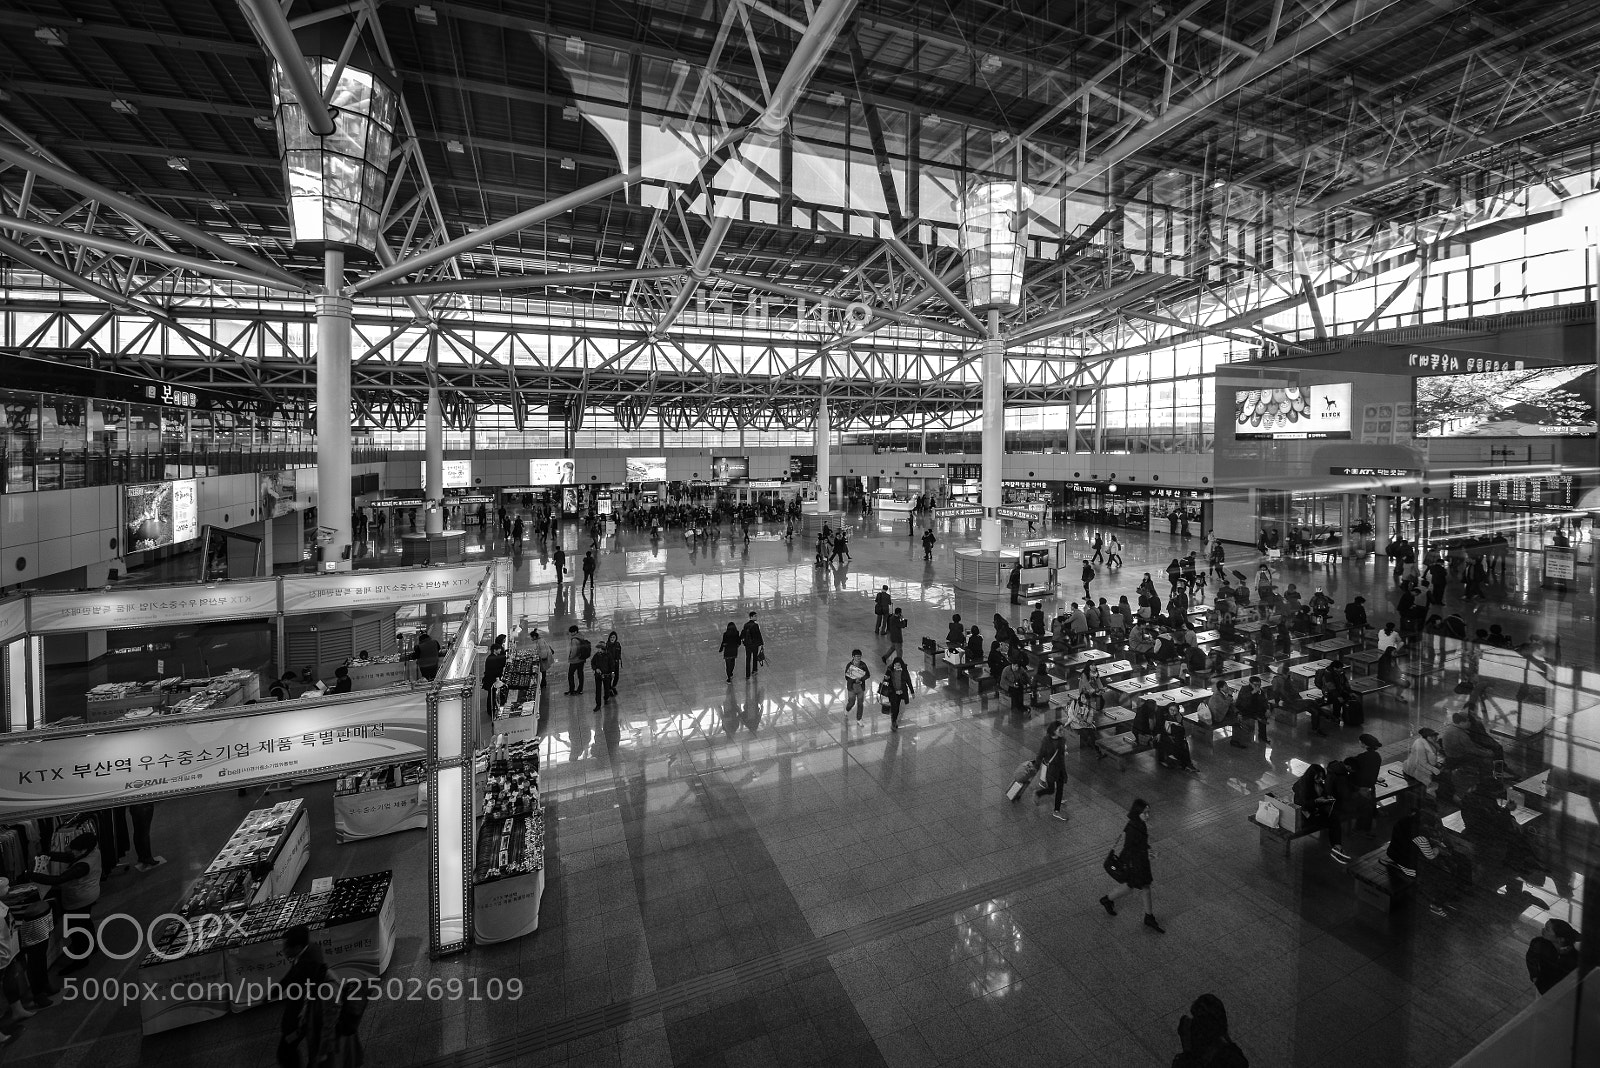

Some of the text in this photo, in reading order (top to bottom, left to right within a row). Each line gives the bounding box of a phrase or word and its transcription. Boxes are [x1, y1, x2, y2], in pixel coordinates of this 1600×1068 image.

[18, 722, 385, 785] KTX 부산역 우수중소기업 제품 특별판매전
[125, 777, 169, 789] KORAIL
